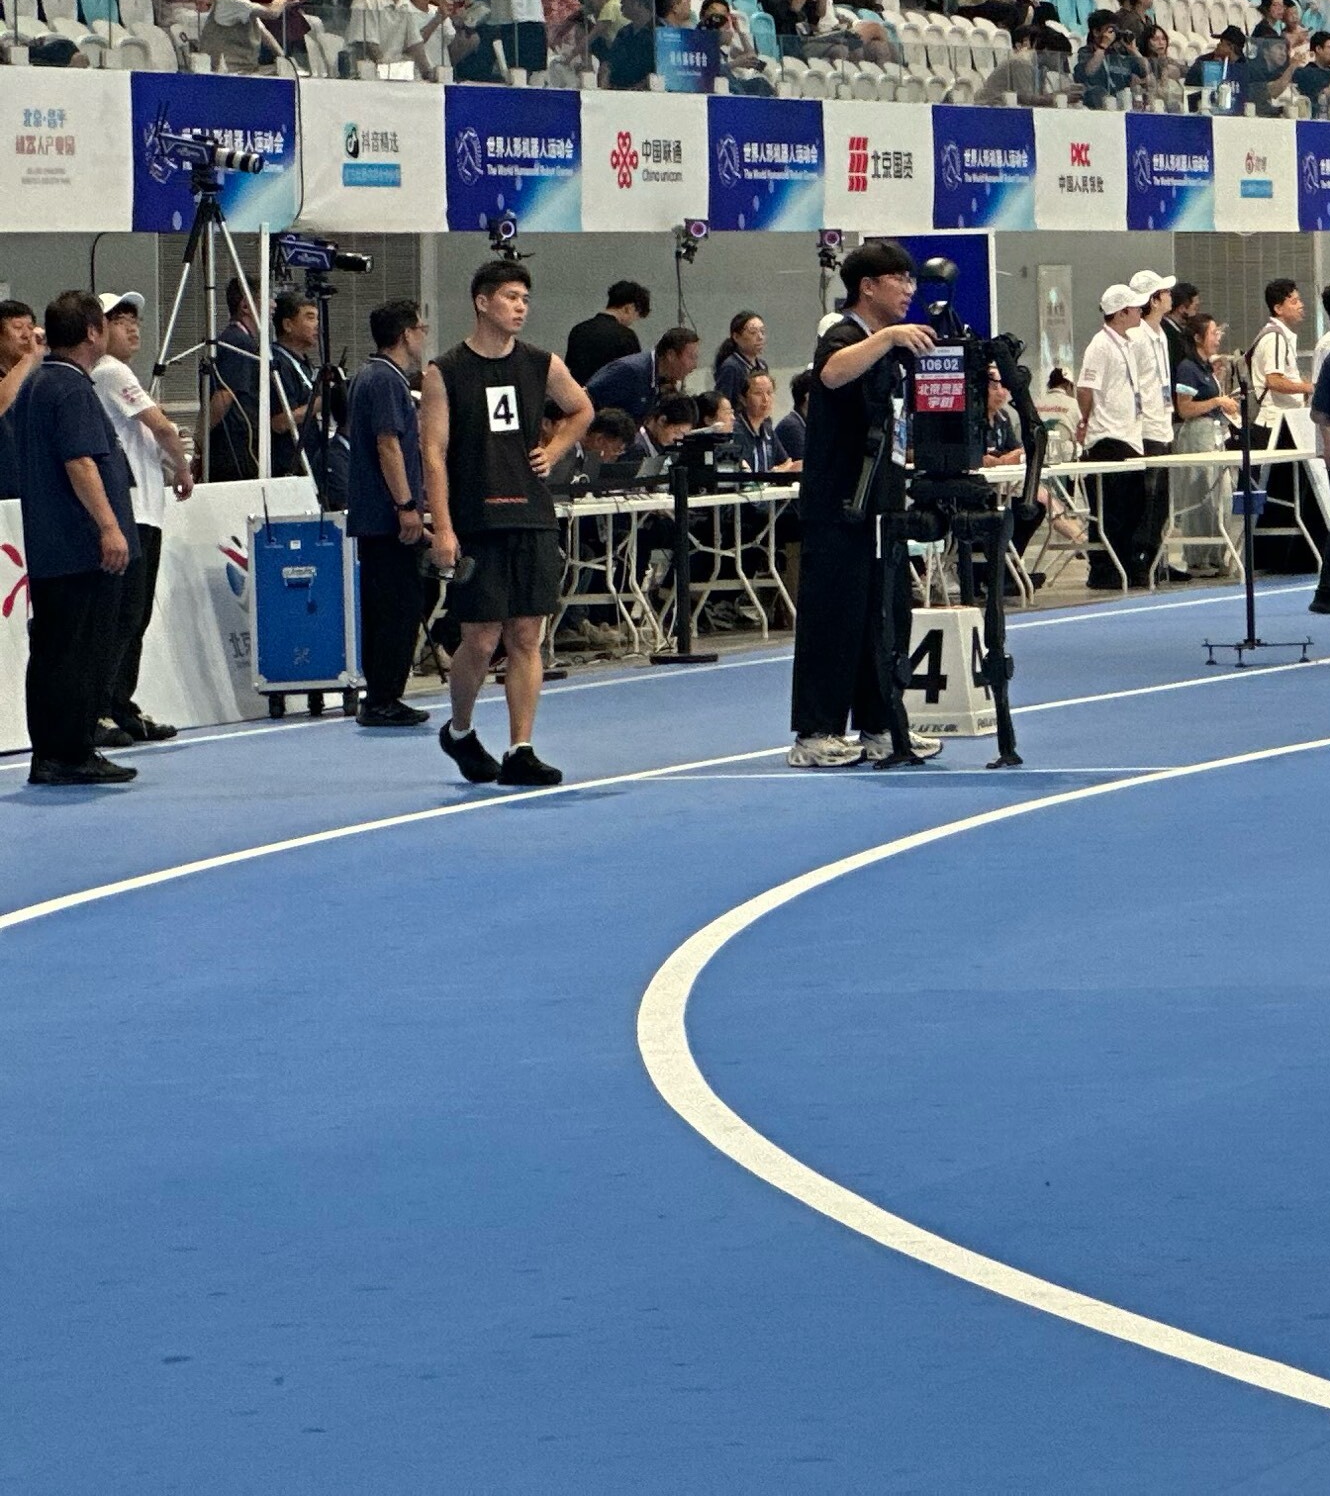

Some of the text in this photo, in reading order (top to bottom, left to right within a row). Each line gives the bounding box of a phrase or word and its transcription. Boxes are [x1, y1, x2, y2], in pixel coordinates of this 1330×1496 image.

[361, 130, 400, 154] 抖音精选
[641, 138, 683, 164] 中国联通
[493, 393, 515, 426] 4
[904, 629, 948, 704] 4
